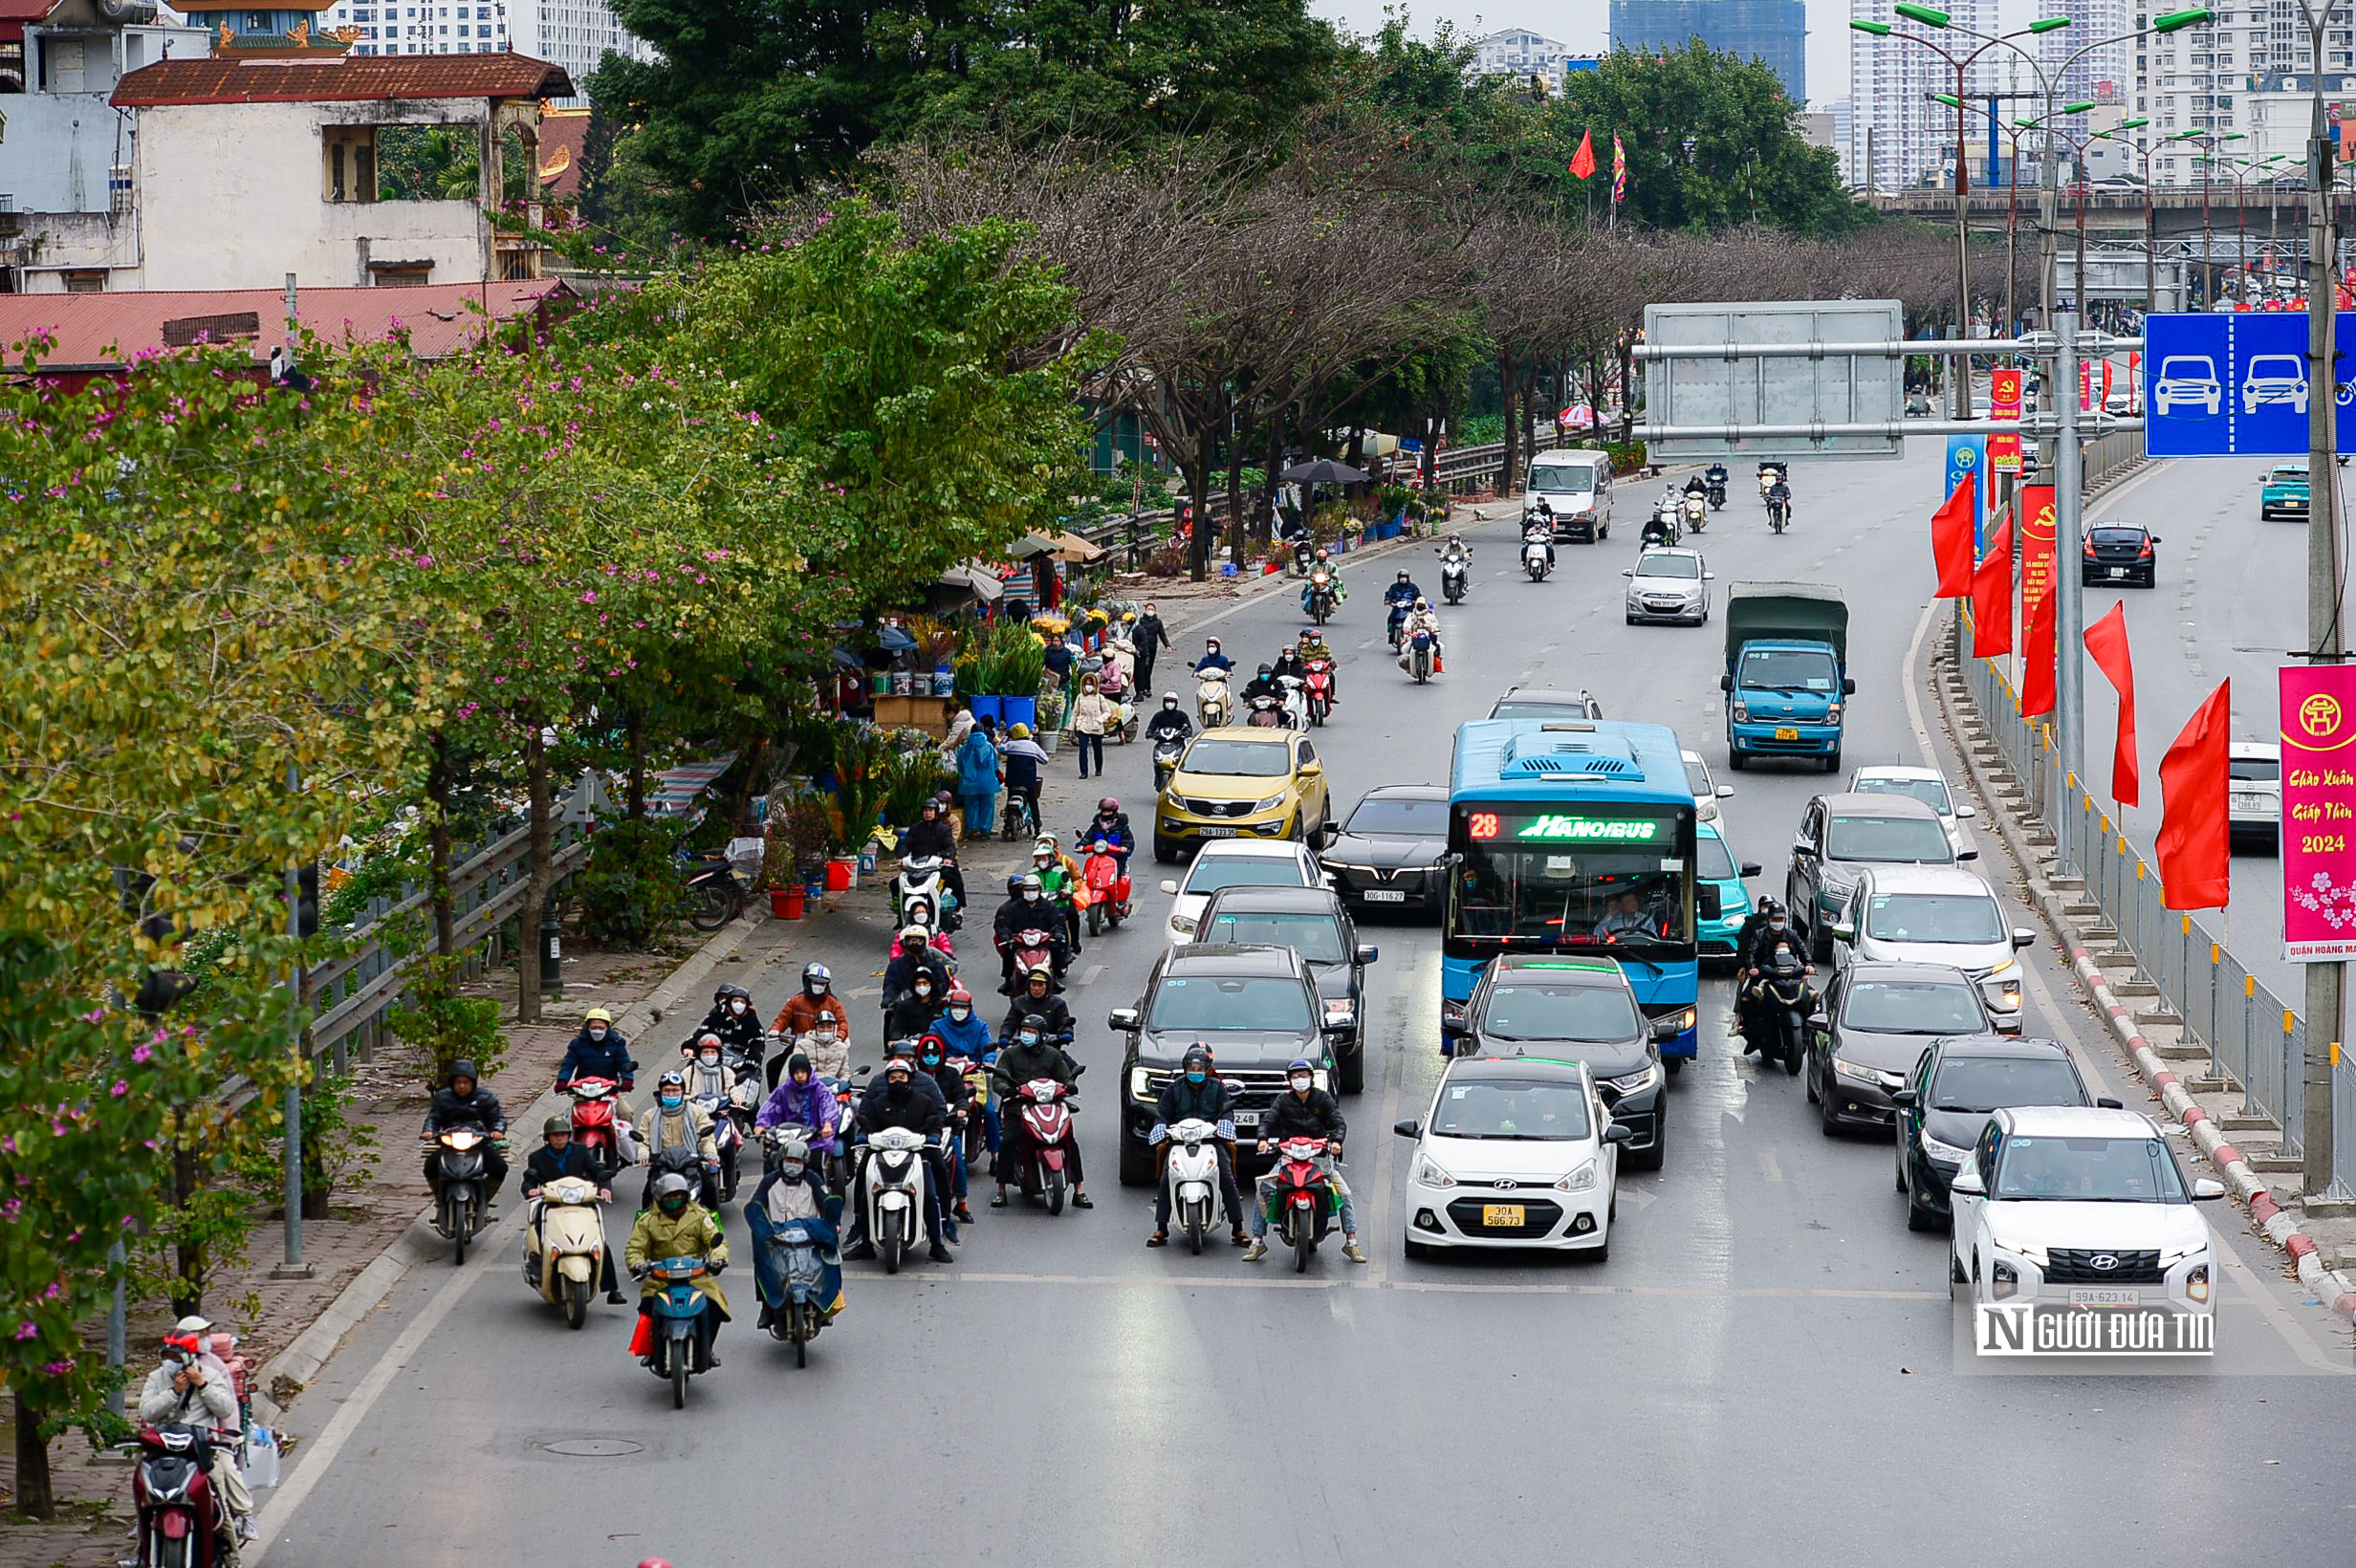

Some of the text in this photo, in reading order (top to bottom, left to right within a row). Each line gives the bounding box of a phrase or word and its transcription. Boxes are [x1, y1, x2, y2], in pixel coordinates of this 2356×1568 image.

[2288, 768, 2354, 788] Chào Xuân
[2292, 801, 2353, 824] Giáp Thìn
[1471, 813, 1656, 838] 28 HANOIBUS
[2301, 835, 2345, 854] 2024
[2289, 945, 2313, 957] QUẬN
[2315, 945, 2344, 954] HOÀNG
[1494, 1207, 1513, 1215] 30A
[2074, 1293, 2134, 1303] 99A-623.14
